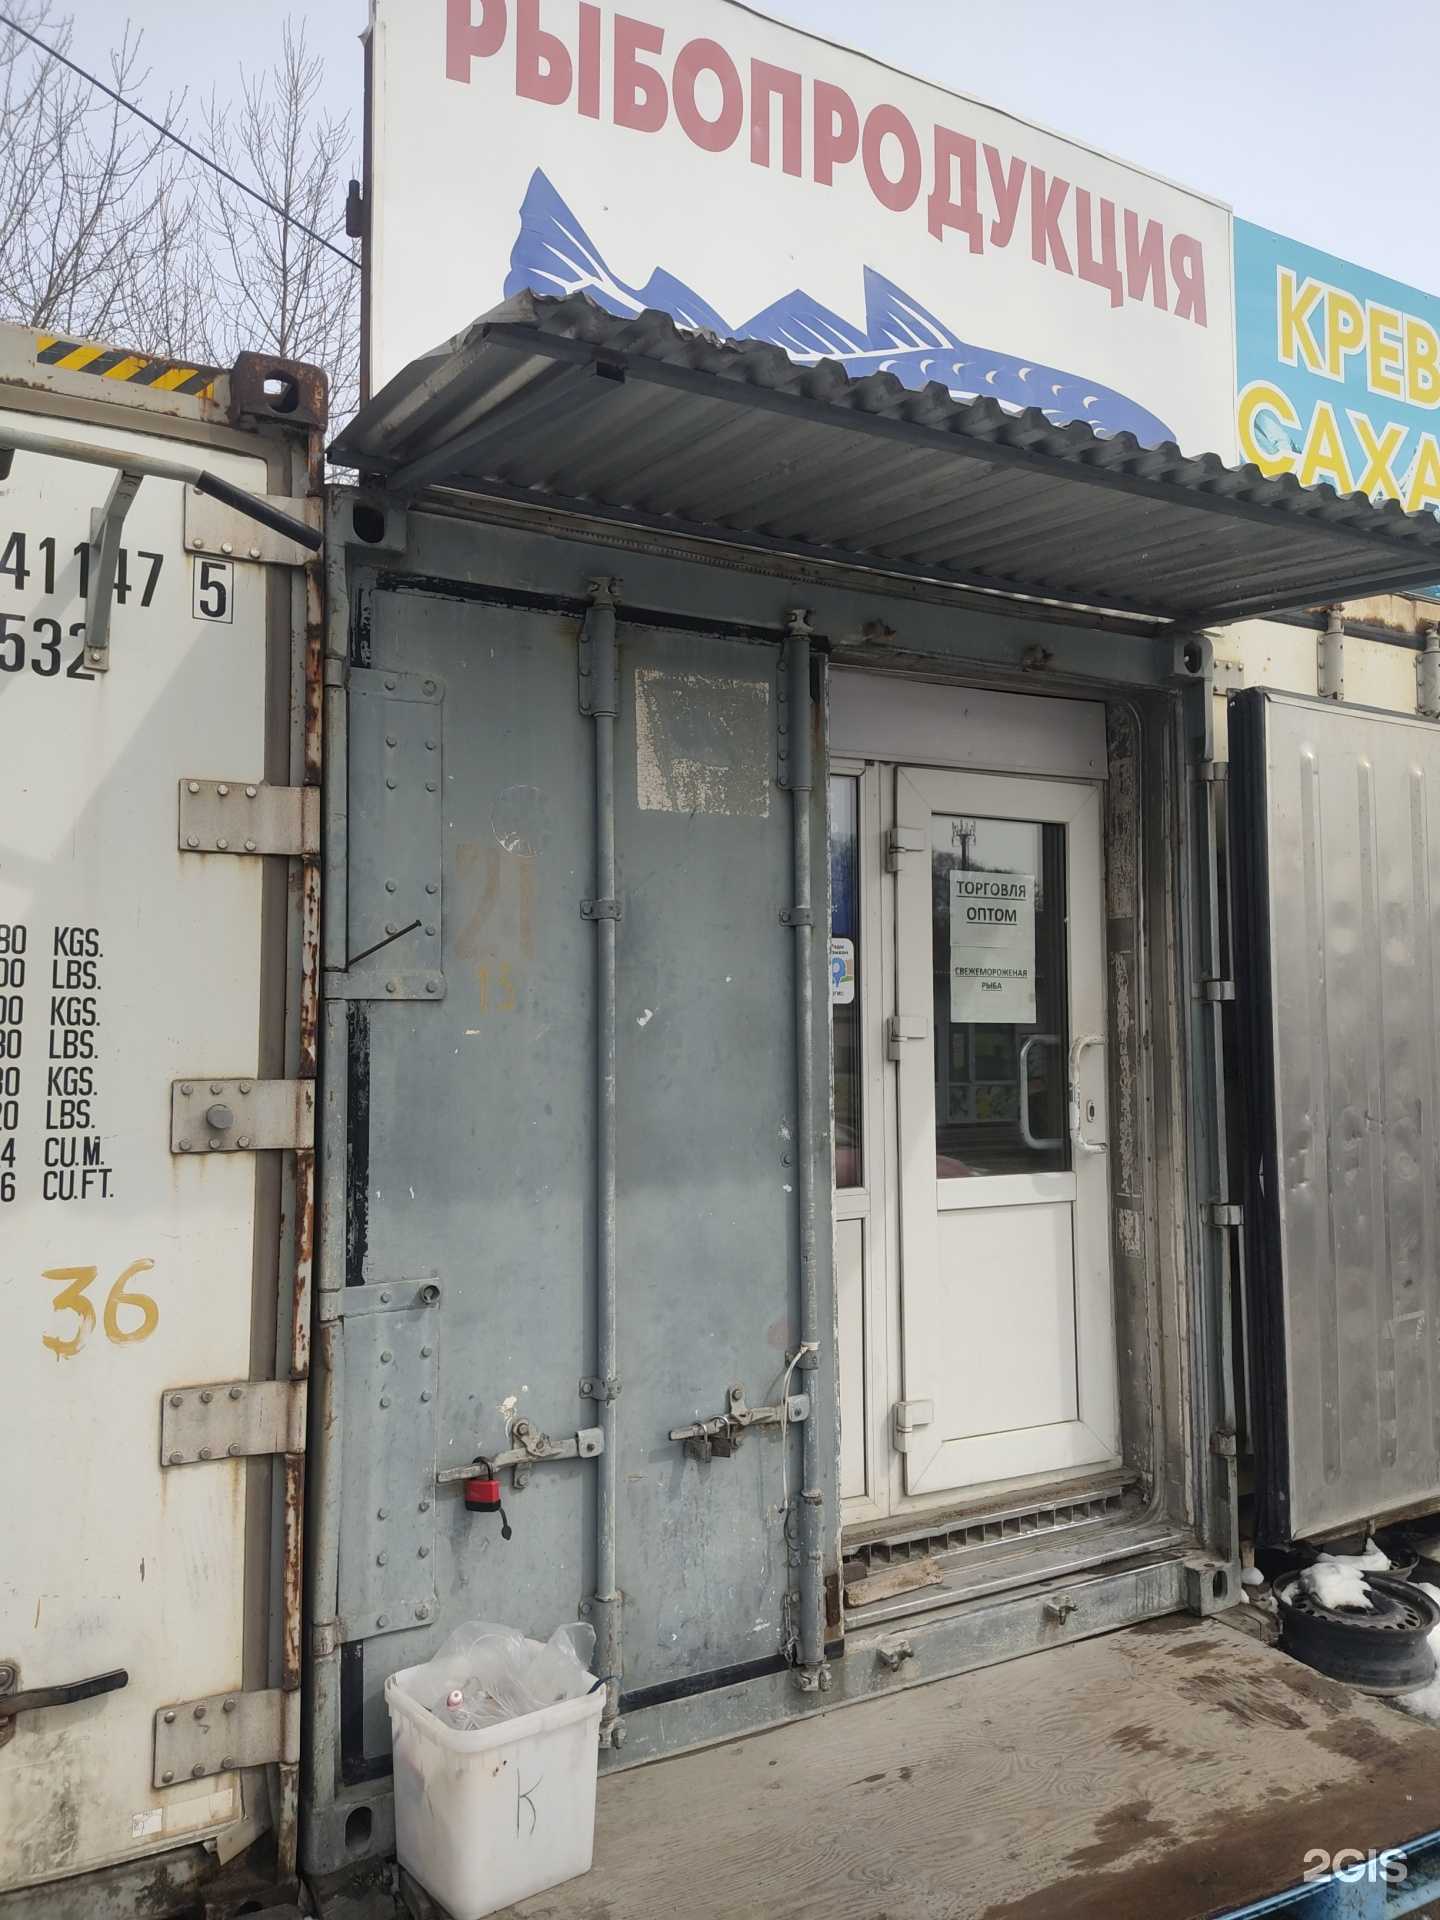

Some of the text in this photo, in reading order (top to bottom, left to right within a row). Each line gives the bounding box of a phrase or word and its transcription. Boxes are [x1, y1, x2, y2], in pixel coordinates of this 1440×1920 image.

[445, 0, 1208, 328] РЫБОПРОДУКЦИЯ
[1276, 264, 1440, 410] КРЕВ
[199, 561, 227, 618] 5
[956, 880, 1026, 898] ТОРГОВЛЯ
[966, 907, 1017, 922] ОПТОМ
[53, 926, 103, 958] KGS.
[52, 959, 101, 990] LBS.
[955, 967, 1028, 977] СВЕЖЕМОРОЖЕНАЯ
[981, 982, 1002, 990] РЫБА
[51, 996, 100, 1026] KGS.
[49, 1029, 98, 1059] LBS.
[47, 1066, 97, 1096] KGS.
[46, 1100, 96, 1129] LBS.
[41, 1257, 159, 1362] 36
